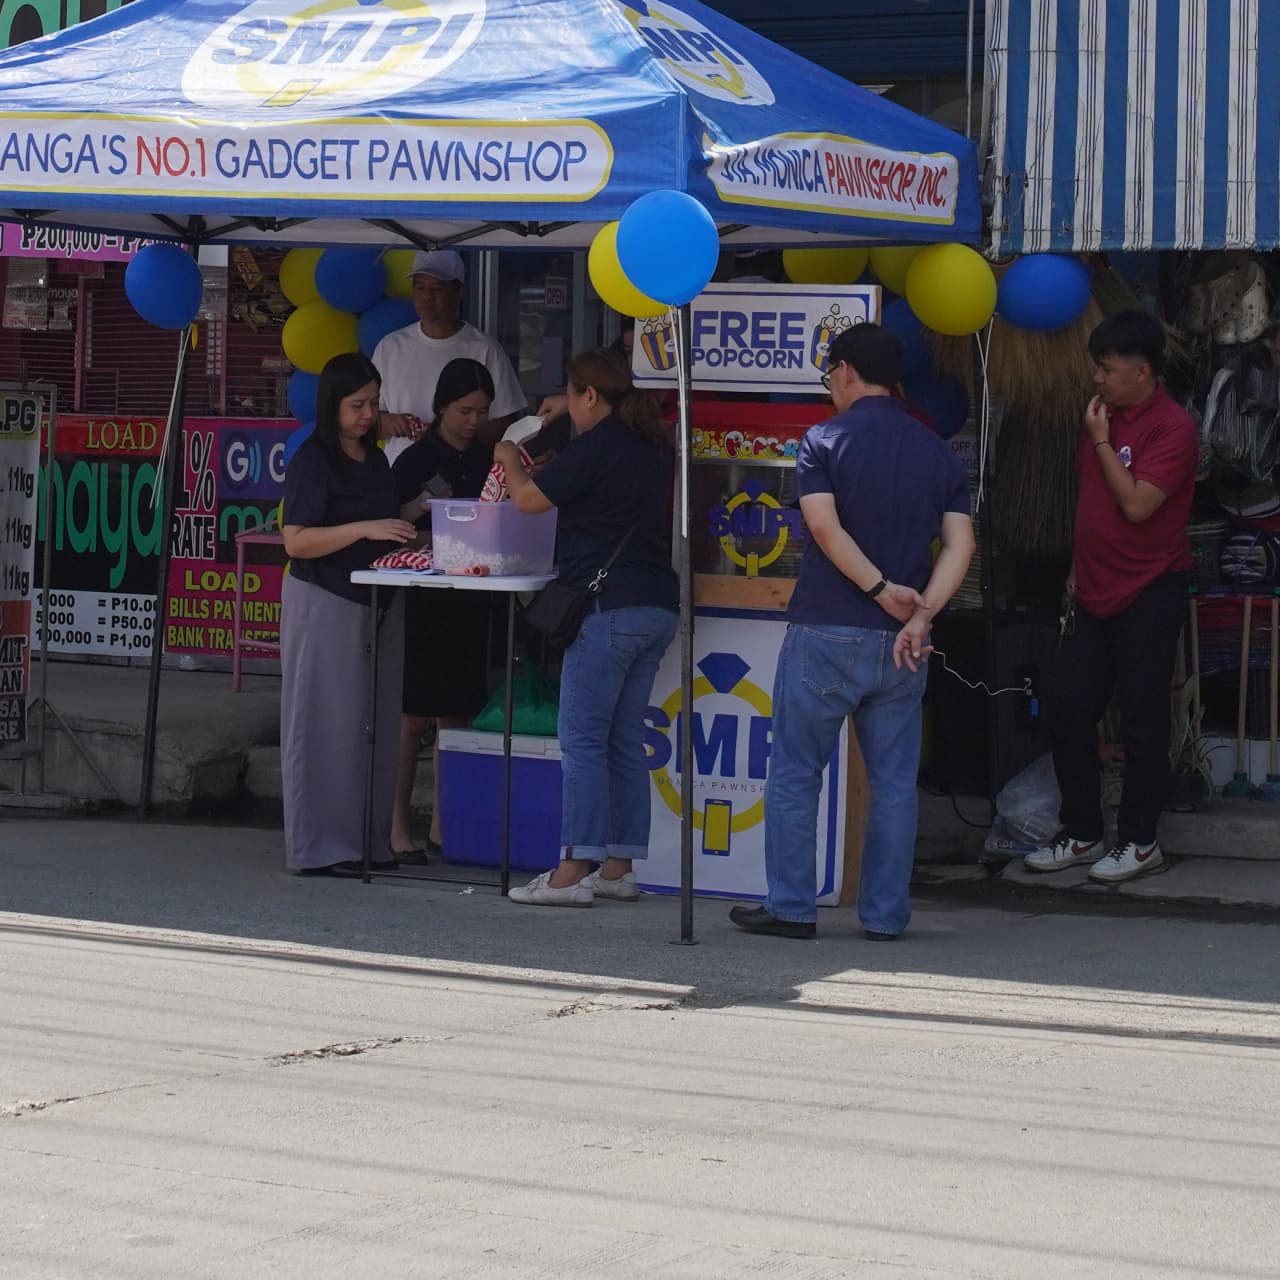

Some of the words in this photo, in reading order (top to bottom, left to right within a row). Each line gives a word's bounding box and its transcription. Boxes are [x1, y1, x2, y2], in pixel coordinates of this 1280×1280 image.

[211, 14, 475, 64] SMPI
[136, 135, 206, 178] NO.1
[215, 137, 360, 180] GADGET
[368, 139, 588, 182] PAWNSHOP
[824, 150, 916, 211] PAWNSHOP,
[915, 165, 947, 208] INC.
[692, 310, 807, 350] FREE
[691, 348, 804, 370] POPCORN
[86, 420, 158, 450] LOAD
[170, 514, 216, 561] RATE
[184, 570, 262, 594] LOAD
[36, 593, 76, 608] 1000
[169, 597, 210, 619] BILLS
[35, 611, 75, 625] 5000
[167, 625, 205, 648] BANK
